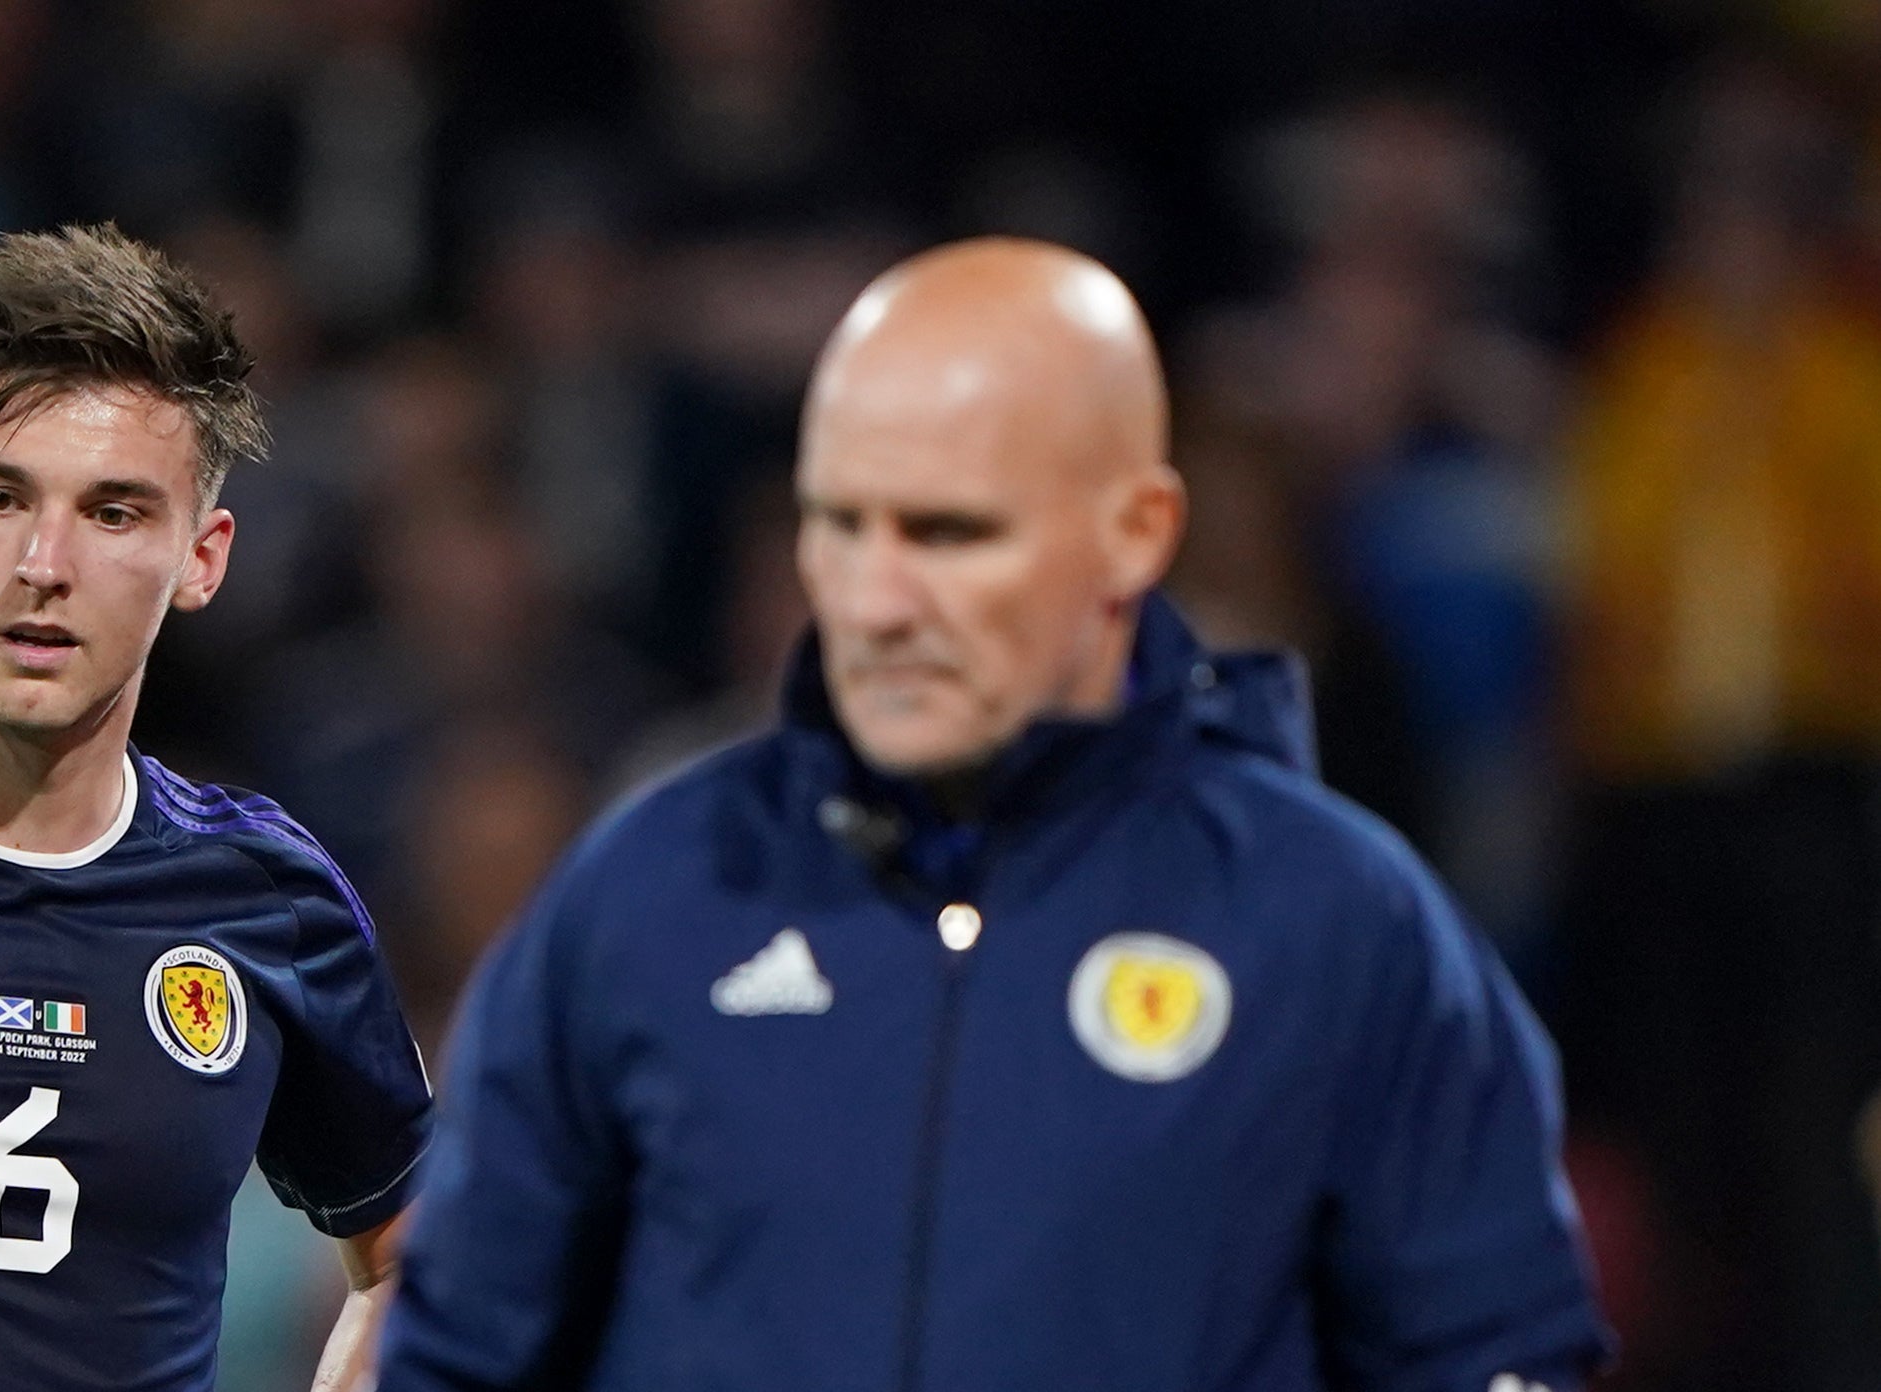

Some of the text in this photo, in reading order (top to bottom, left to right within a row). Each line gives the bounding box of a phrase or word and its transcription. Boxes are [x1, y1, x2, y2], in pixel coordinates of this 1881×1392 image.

[166, 950, 219, 968] SCOTLAND
[54, 1037, 97, 1050] GLASGOW
[168, 1044, 183, 1059] EST
[6, 1045, 58, 1061] SEPTEMBER
[60, 1050, 86, 1063] 2022
